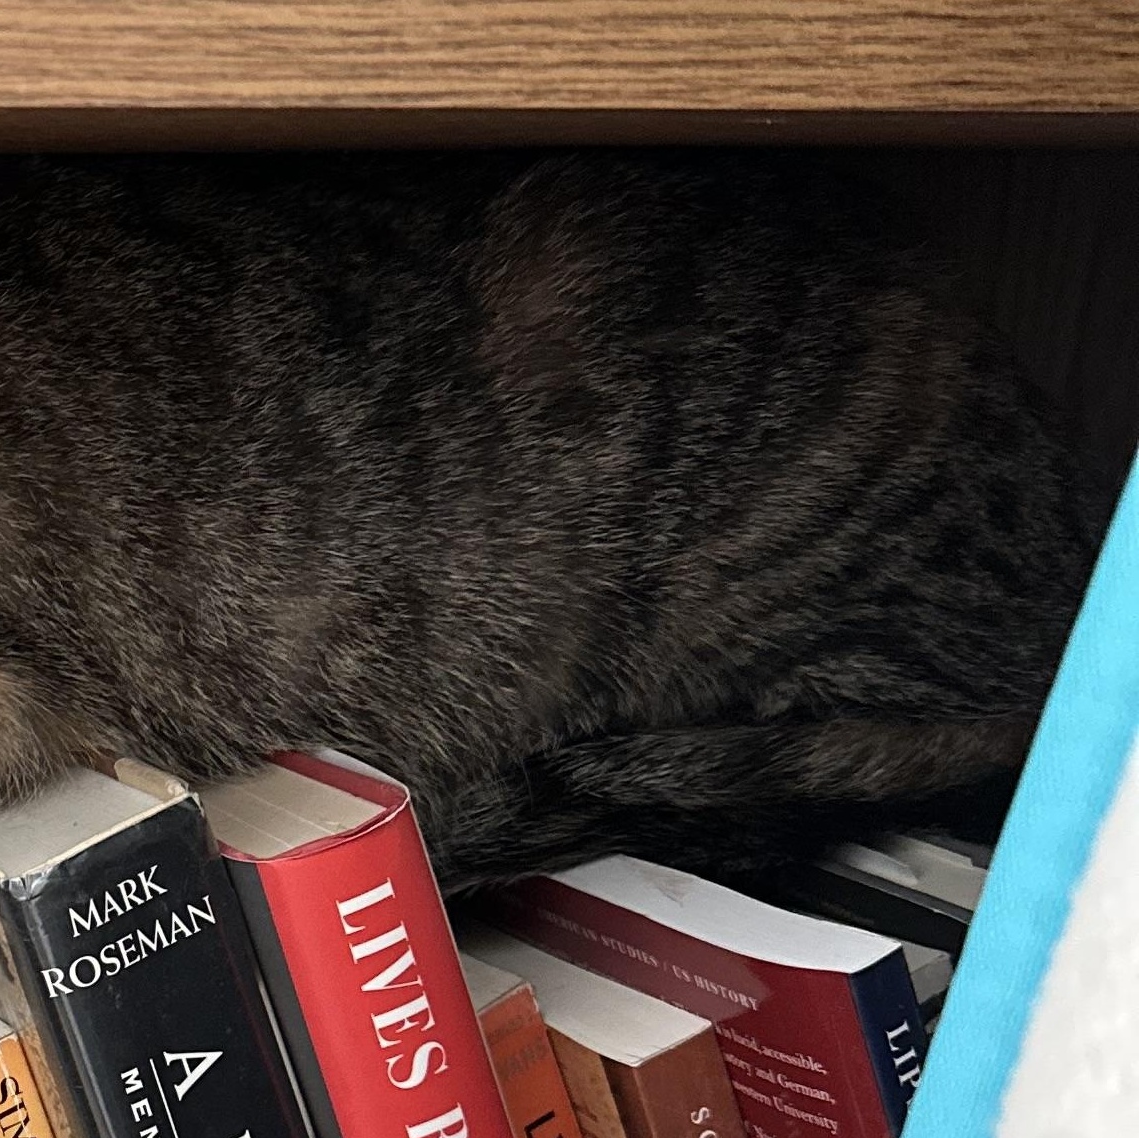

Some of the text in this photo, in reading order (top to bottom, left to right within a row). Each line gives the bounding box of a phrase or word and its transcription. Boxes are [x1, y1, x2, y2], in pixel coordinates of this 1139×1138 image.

[67, 864, 167, 937] MARK
[40, 896, 217, 999] ROSEMAN
[336, 877, 448, 1090] LIVES
[600, 935, 659, 968] STUDIES
[671, 963, 691, 984] US
[694, 973, 758, 1011] HISTORY
[163, 1049, 223, 1101] A
[776, 1072, 836, 1105] German,
[772, 1096, 838, 1135] University
